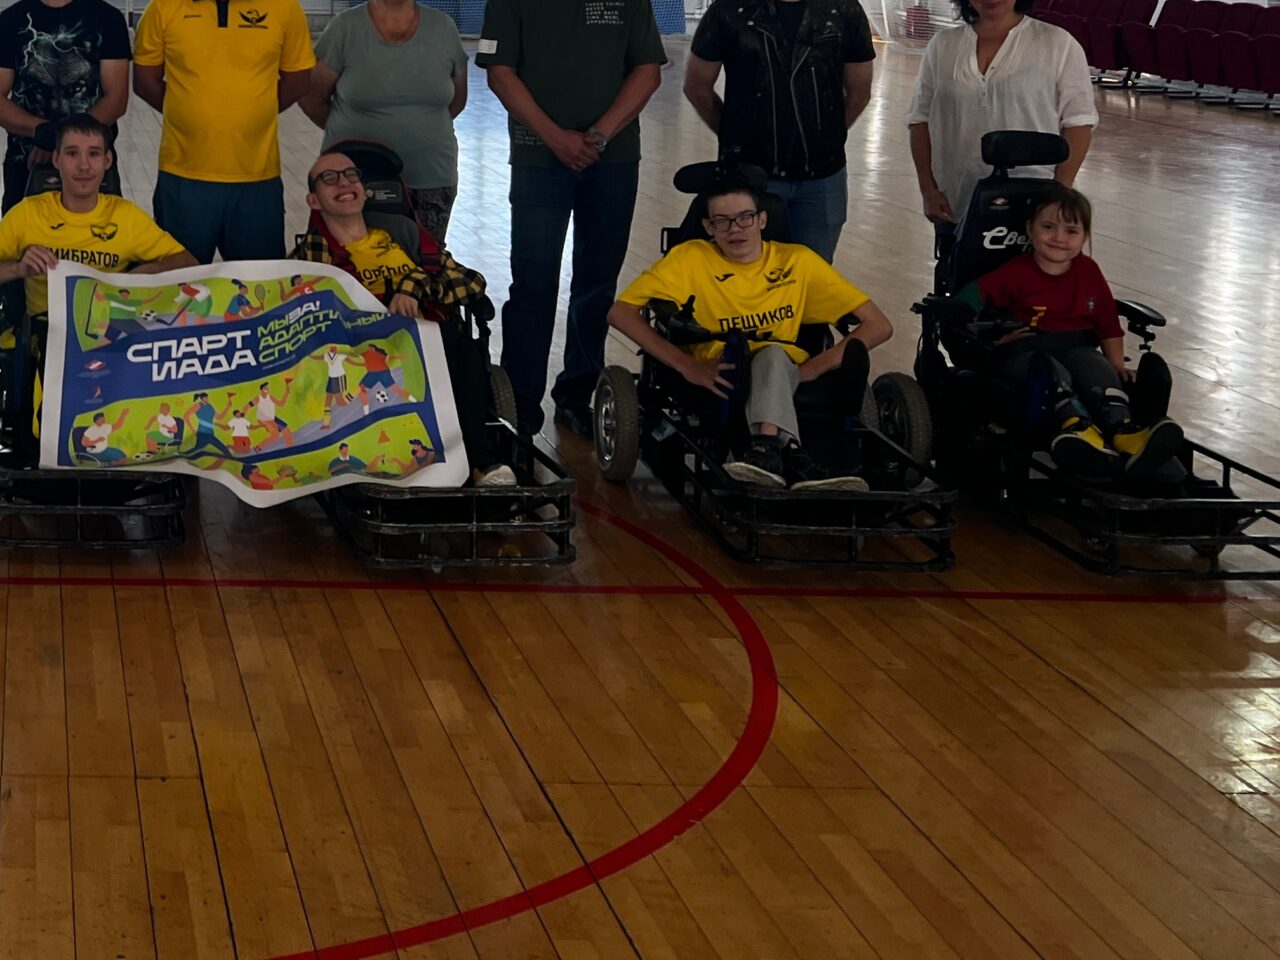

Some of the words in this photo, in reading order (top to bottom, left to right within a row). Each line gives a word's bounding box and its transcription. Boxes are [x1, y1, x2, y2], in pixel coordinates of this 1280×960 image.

[46, 247, 120, 268] МИБРАТОВ
[719, 304, 795, 332] ПЕЩИКОВ
[1029, 306, 1048, 327] 7
[126, 329, 252, 363] СПАРТ
[259, 321, 332, 363] СПОРТ
[151, 349, 258, 382] ИАДА
